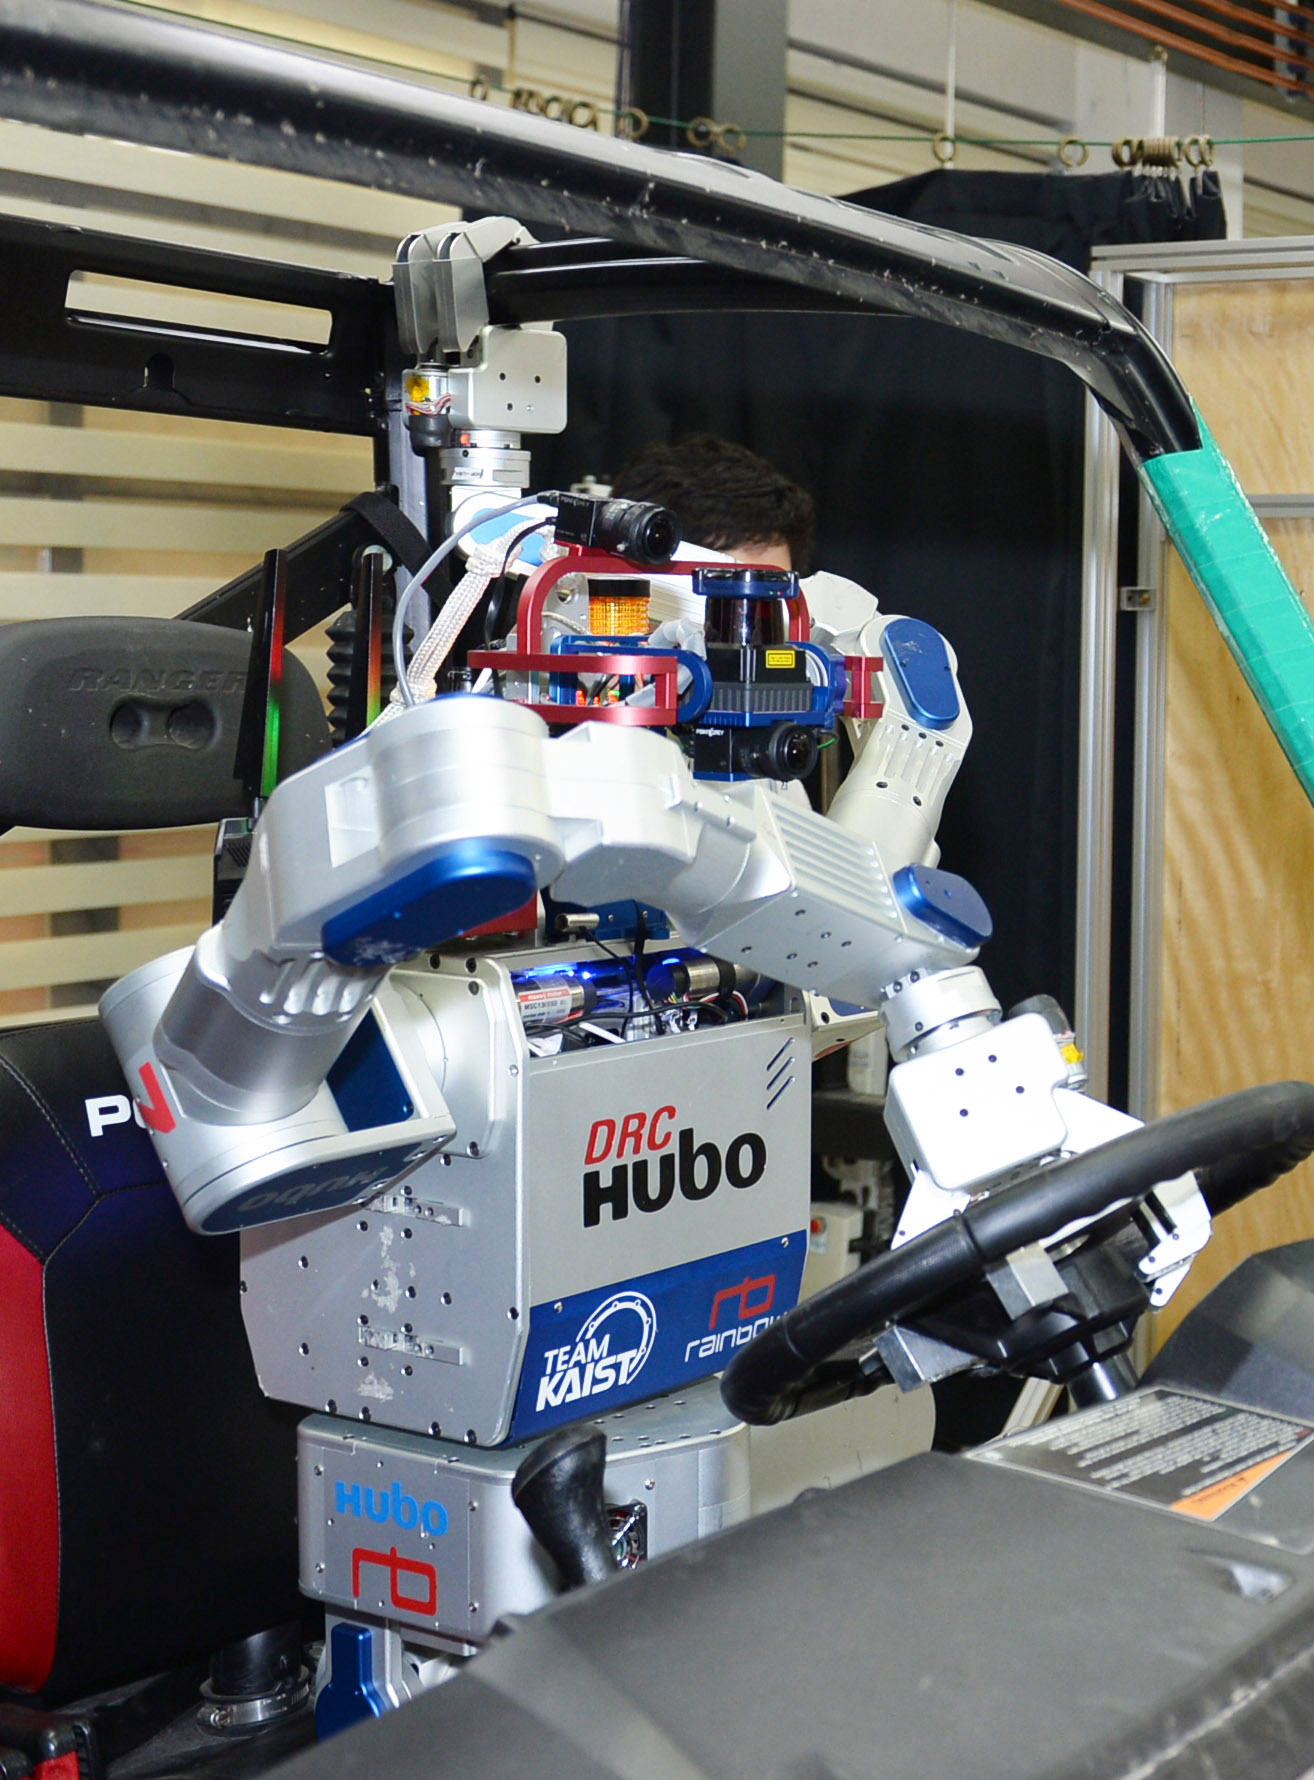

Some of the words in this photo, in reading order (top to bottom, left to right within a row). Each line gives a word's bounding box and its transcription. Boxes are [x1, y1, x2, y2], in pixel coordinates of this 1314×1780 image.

[85, 1094, 147, 1138] P
[584, 1105, 676, 1165] DRC
[536, 1349, 637, 1412] KAIST
[544, 1334, 610, 1375] TEAM
